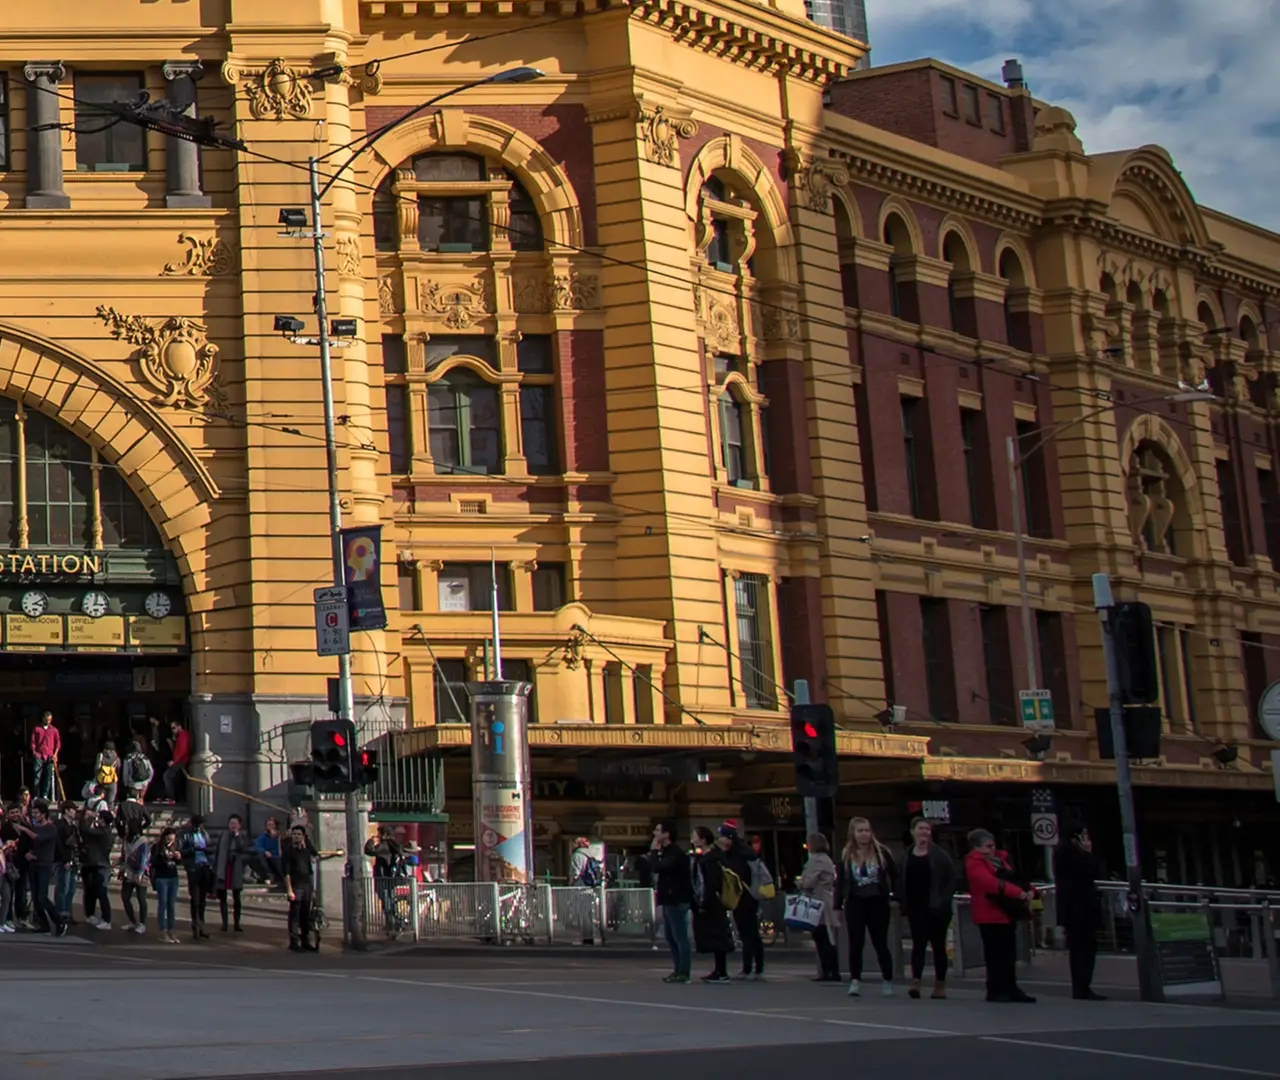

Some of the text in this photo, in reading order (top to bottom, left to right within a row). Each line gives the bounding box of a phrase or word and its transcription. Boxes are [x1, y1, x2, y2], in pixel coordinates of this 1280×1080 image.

[9, 616, 59, 624] BROADMEADOWS
[71, 617, 95, 625] UPFIELD
[483, 805, 521, 813] MELBOURNE
[1037, 823, 1053, 834] 40
